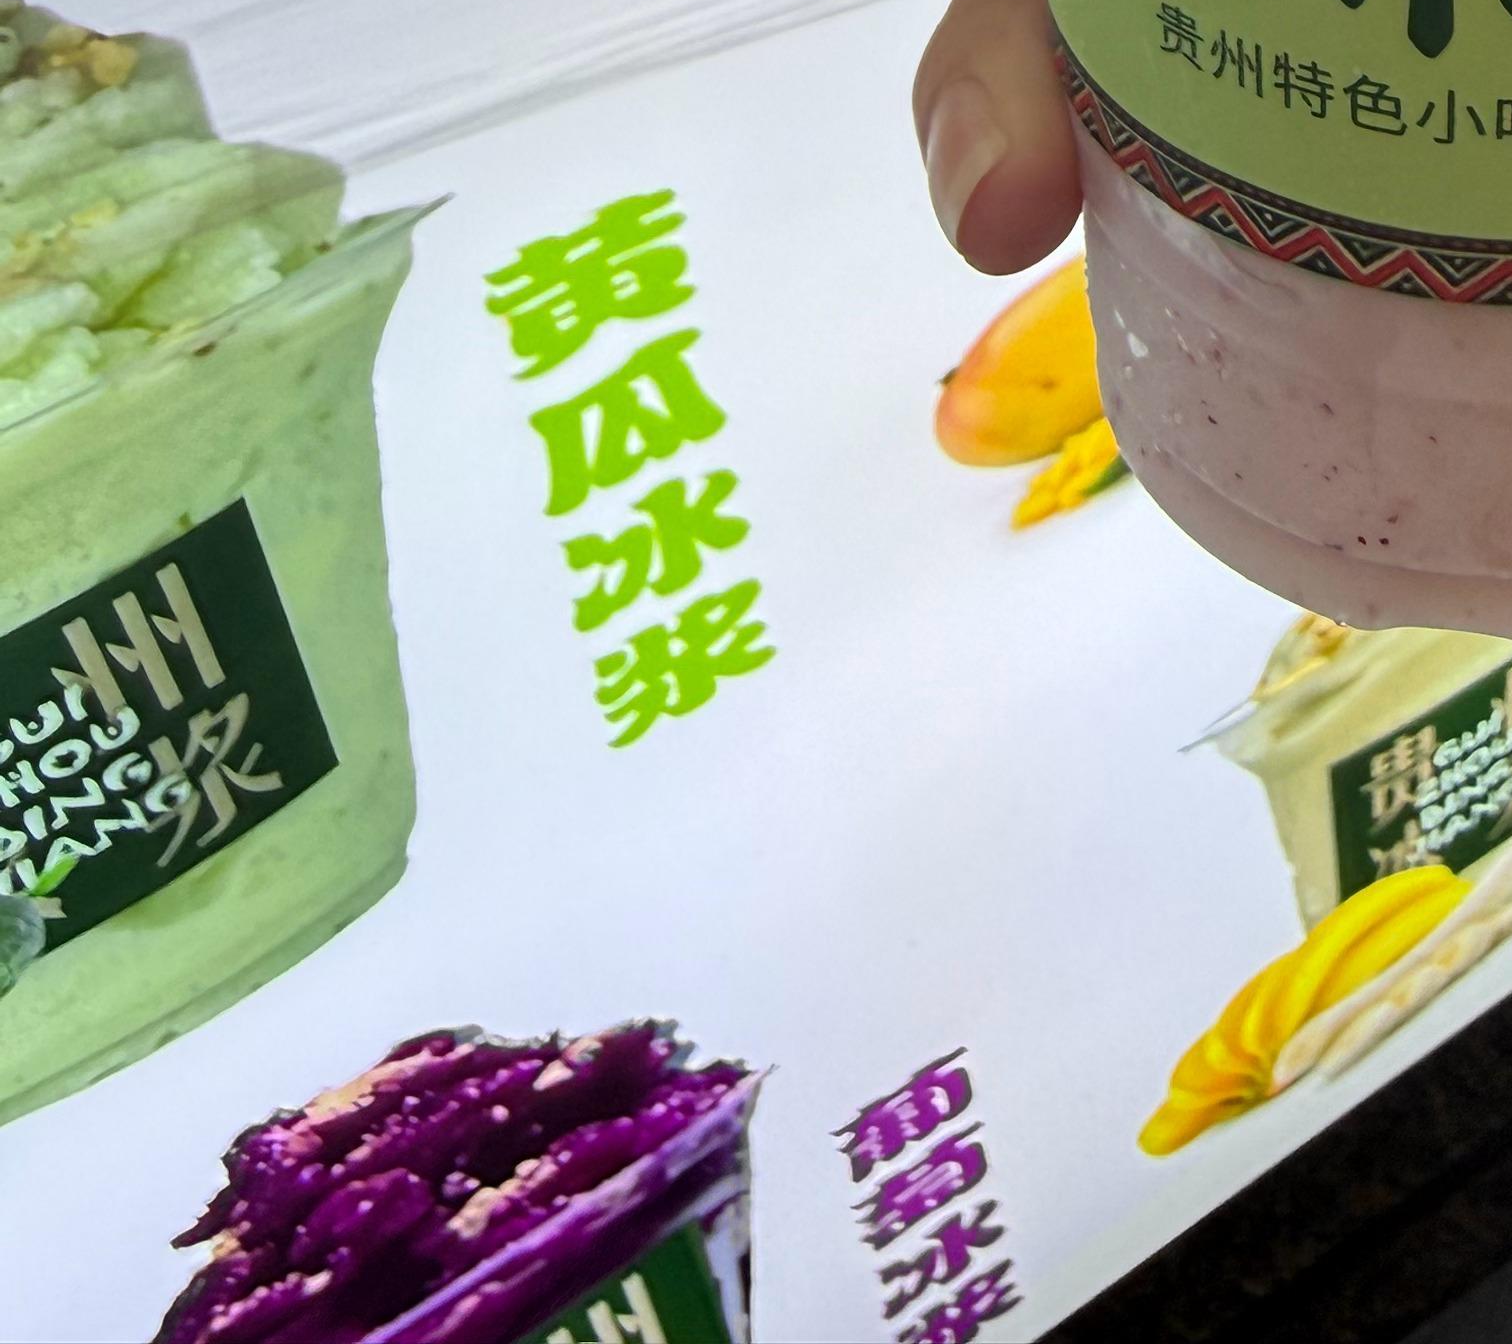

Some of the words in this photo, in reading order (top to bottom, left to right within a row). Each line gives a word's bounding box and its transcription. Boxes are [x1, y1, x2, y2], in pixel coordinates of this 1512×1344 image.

[484, 188, 777, 749] 黄瓜冰浆
[0, 684, 89, 764] UI
